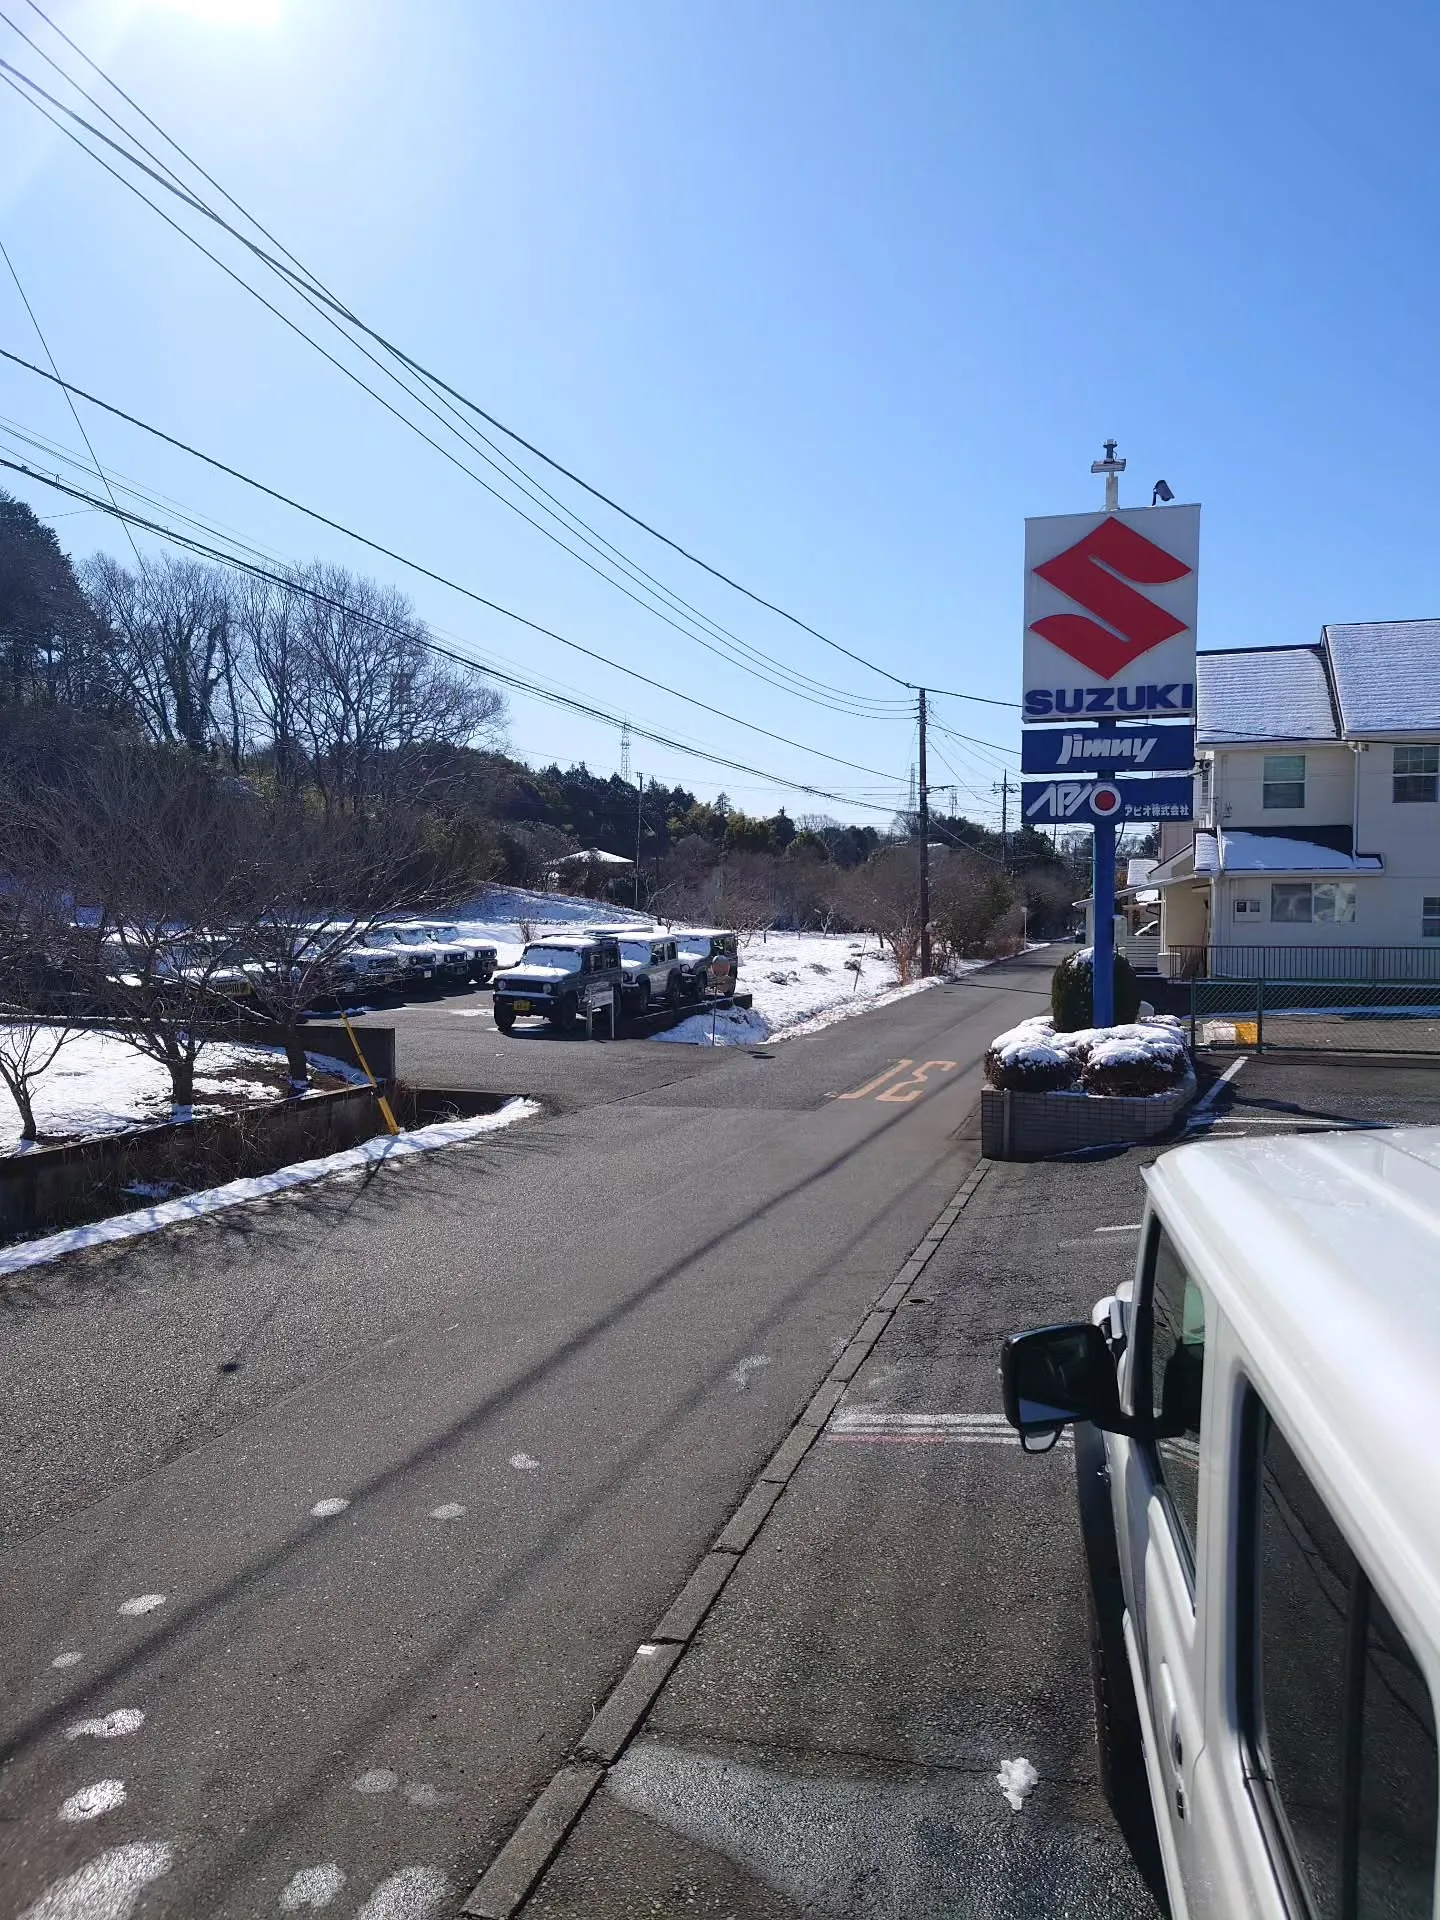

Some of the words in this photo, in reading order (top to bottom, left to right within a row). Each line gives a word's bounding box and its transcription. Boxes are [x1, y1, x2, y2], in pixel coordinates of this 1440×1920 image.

[1024, 683, 1193, 715] SUZUKI
[1056, 733, 1158, 765] Jimny
[1124, 803, 1190, 817] アピオ株式会社
